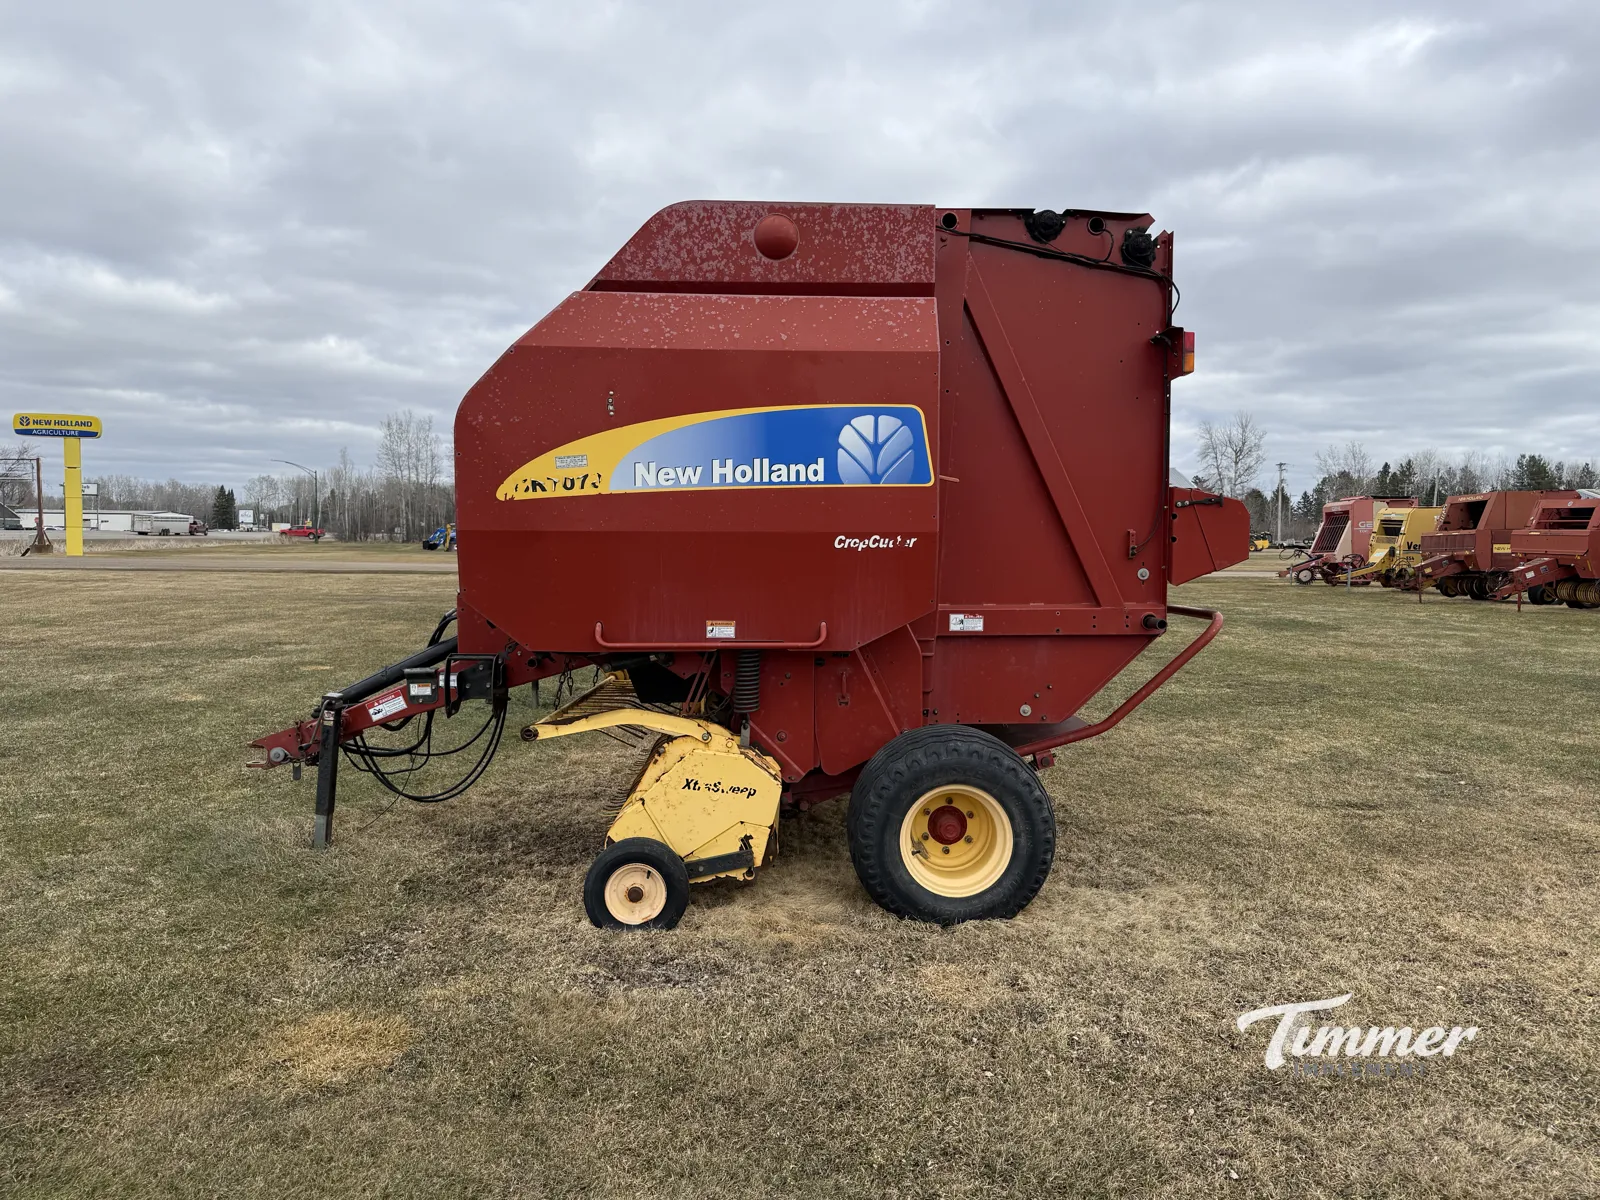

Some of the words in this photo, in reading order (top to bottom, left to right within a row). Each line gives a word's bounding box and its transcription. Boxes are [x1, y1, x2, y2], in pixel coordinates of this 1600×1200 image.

[54, 419, 92, 428] HOLLAND
[32, 429, 79, 437] AGRICULTURE
[633, 461, 703, 487] New
[711, 457, 826, 484] Holland
